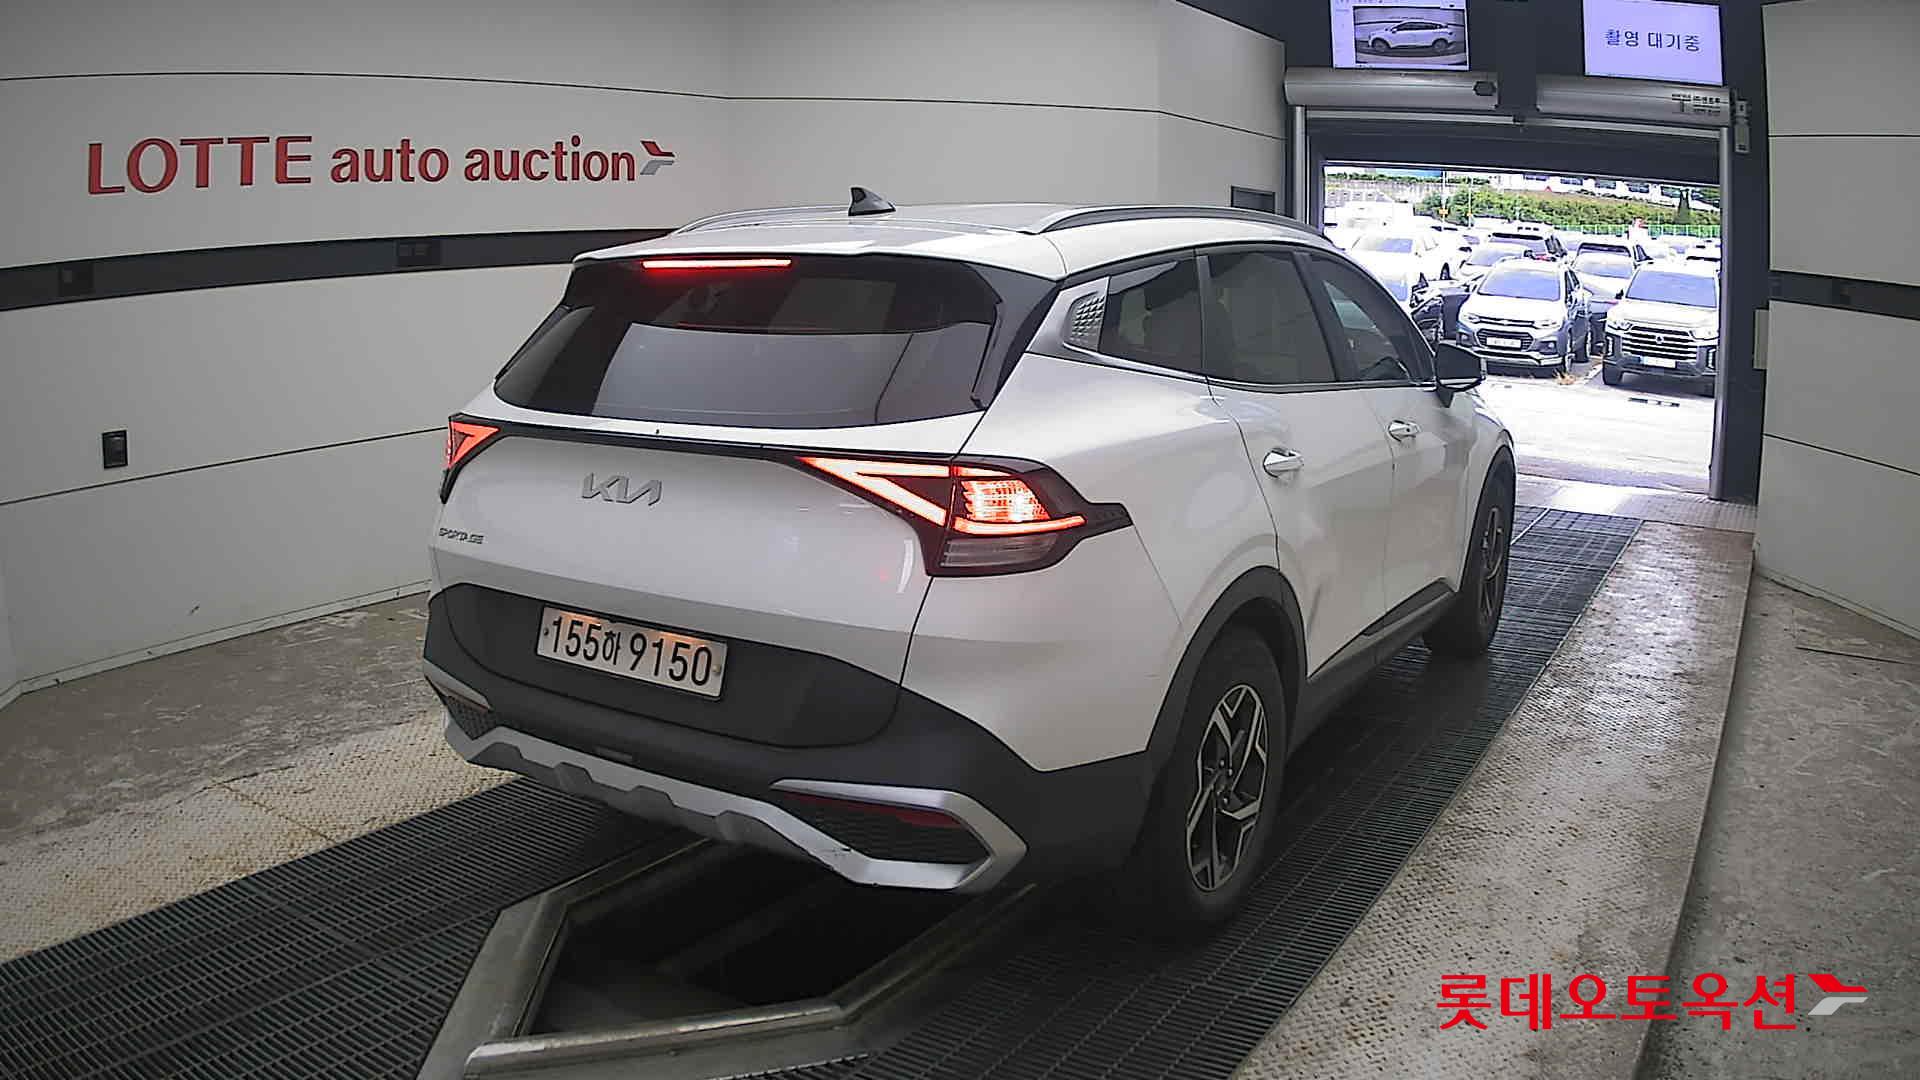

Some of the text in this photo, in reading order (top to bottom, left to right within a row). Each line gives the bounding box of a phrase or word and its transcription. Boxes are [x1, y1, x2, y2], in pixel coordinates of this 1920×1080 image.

[1648, 32, 1700, 52] 대기중
[89, 135, 635, 194] LOTTE auto auction
[581, 472, 664, 507] KIA
[629, 632, 713, 686] 9150
